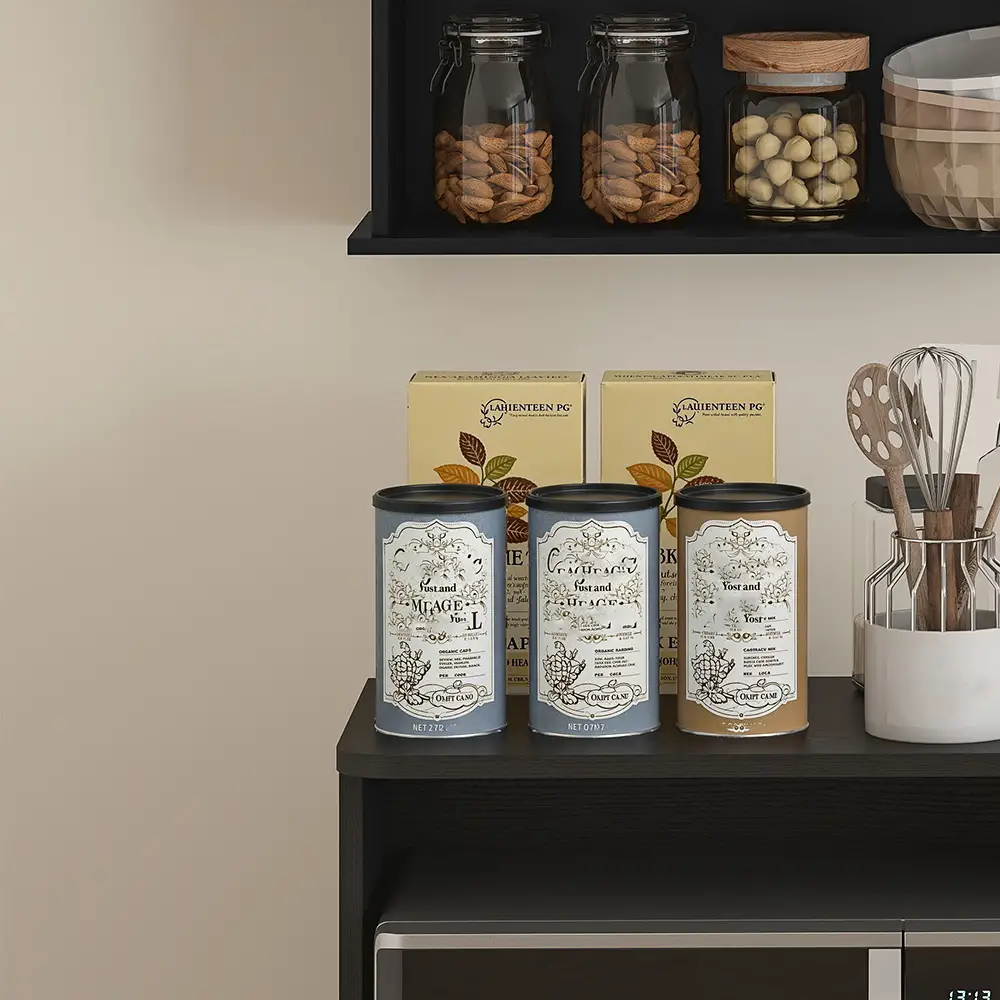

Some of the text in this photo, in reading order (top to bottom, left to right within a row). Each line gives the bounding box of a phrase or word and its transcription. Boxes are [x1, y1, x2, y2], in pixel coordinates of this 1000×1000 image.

[556, 403, 571, 412] PG
[749, 402, 764, 411] PG
[440, 583, 457, 593] and
[594, 582, 611, 592] and
[743, 582, 761, 591] and
